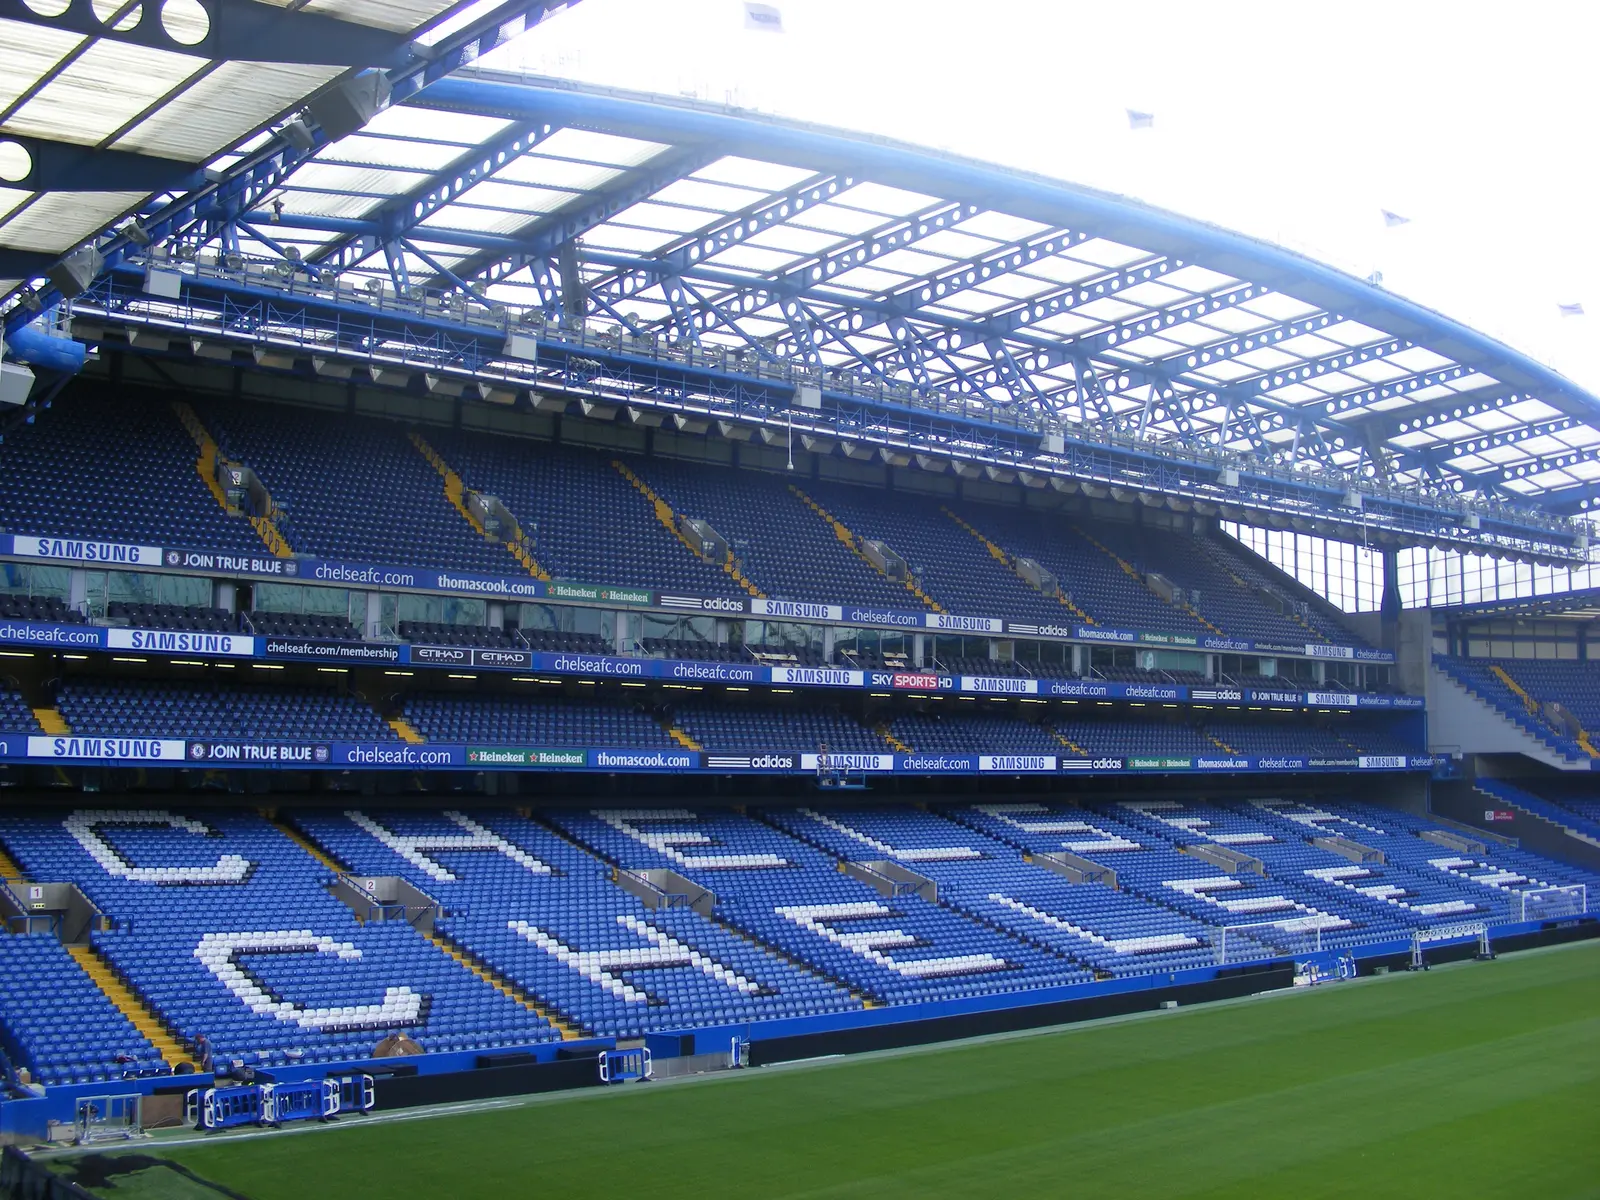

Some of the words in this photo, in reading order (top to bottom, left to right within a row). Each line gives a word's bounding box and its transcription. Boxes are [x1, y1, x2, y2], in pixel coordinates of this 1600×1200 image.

[38, 538, 140, 563] SAMSUNG
[183, 553, 214, 568] JOIN
[216, 556, 249, 571] TRUE
[251, 559, 282, 573] BLUE
[315, 563, 414, 586] chelseafc.com
[438, 574, 535, 596] thomascook.com
[557, 586, 597, 599] Heineken
[609, 590, 648, 603] Heineken
[703, 598, 744, 612] adidas
[766, 601, 829, 618] SAMSUNG
[851, 609, 918, 626] chelseafc.com
[938, 615, 991, 631] SAMSUNG
[0, 625, 99, 644] chelseafc.com
[1038, 625, 1068, 637] adidas
[1078, 628, 1134, 641] thomascook.com
[131, 631, 232, 653] SAMSUNG
[1145, 634, 1168, 642] Heineken
[1174, 636, 1197, 645] Heineken
[1204, 637, 1249, 650] chelseafc.com
[267, 642, 399, 661] chelseafc.com/membership
[419, 649, 464, 659] ETIHAD
[481, 652, 525, 662] ETIHAD
[1313, 645, 1347, 659] SAMSUNG
[1356, 649, 1393, 660] chelseafc.com
[554, 656, 642, 674] chelseafc.com
[673, 663, 753, 681] chelseafc.com
[786, 668, 850, 684] SAMSUNG
[872, 674, 893, 686] SKY
[895, 676, 937, 688] SPORTS
[938, 677, 953, 689] HD
[974, 678, 1027, 692] SAMSUNG
[1051, 682, 1107, 696] chelseafc.com
[1125, 685, 1177, 699] chelseafc.com
[1217, 689, 1242, 700] adidas
[1258, 692, 1271, 702] JOIN
[1270, 692, 1284, 702] TRUE
[1284, 693, 1297, 703] BLUE
[1315, 694, 1351, 705] SAMSUNG
[1359, 696, 1390, 705] chelseafc.com
[54, 738, 162, 758] SAMSUNG
[208, 744, 240, 759] JOIN
[243, 745, 278, 760] TRUE
[280, 747, 312, 761] BLUE
[347, 746, 451, 764] chelseafc.com
[480, 751, 525, 763] Heineken
[539, 753, 583, 764] Heineken
[597, 752, 690, 767] thomascook.com
[751, 755, 793, 768] adidas
[817, 755, 880, 769] SAMSUNG
[903, 756, 970, 770] chelseafc.com
[991, 757, 1045, 769] SAMSUNG
[1092, 757, 1122, 769] adidas
[1134, 759, 1160, 767] Heineken
[1166, 759, 1191, 767] Heineken
[1197, 757, 1248, 769] thomascook.com
[1258, 757, 1303, 769] chelseafc.com
[1366, 757, 1400, 767] SAMSUNG
[368, 881, 374, 890] 2
[34, 888, 40, 897] 1
